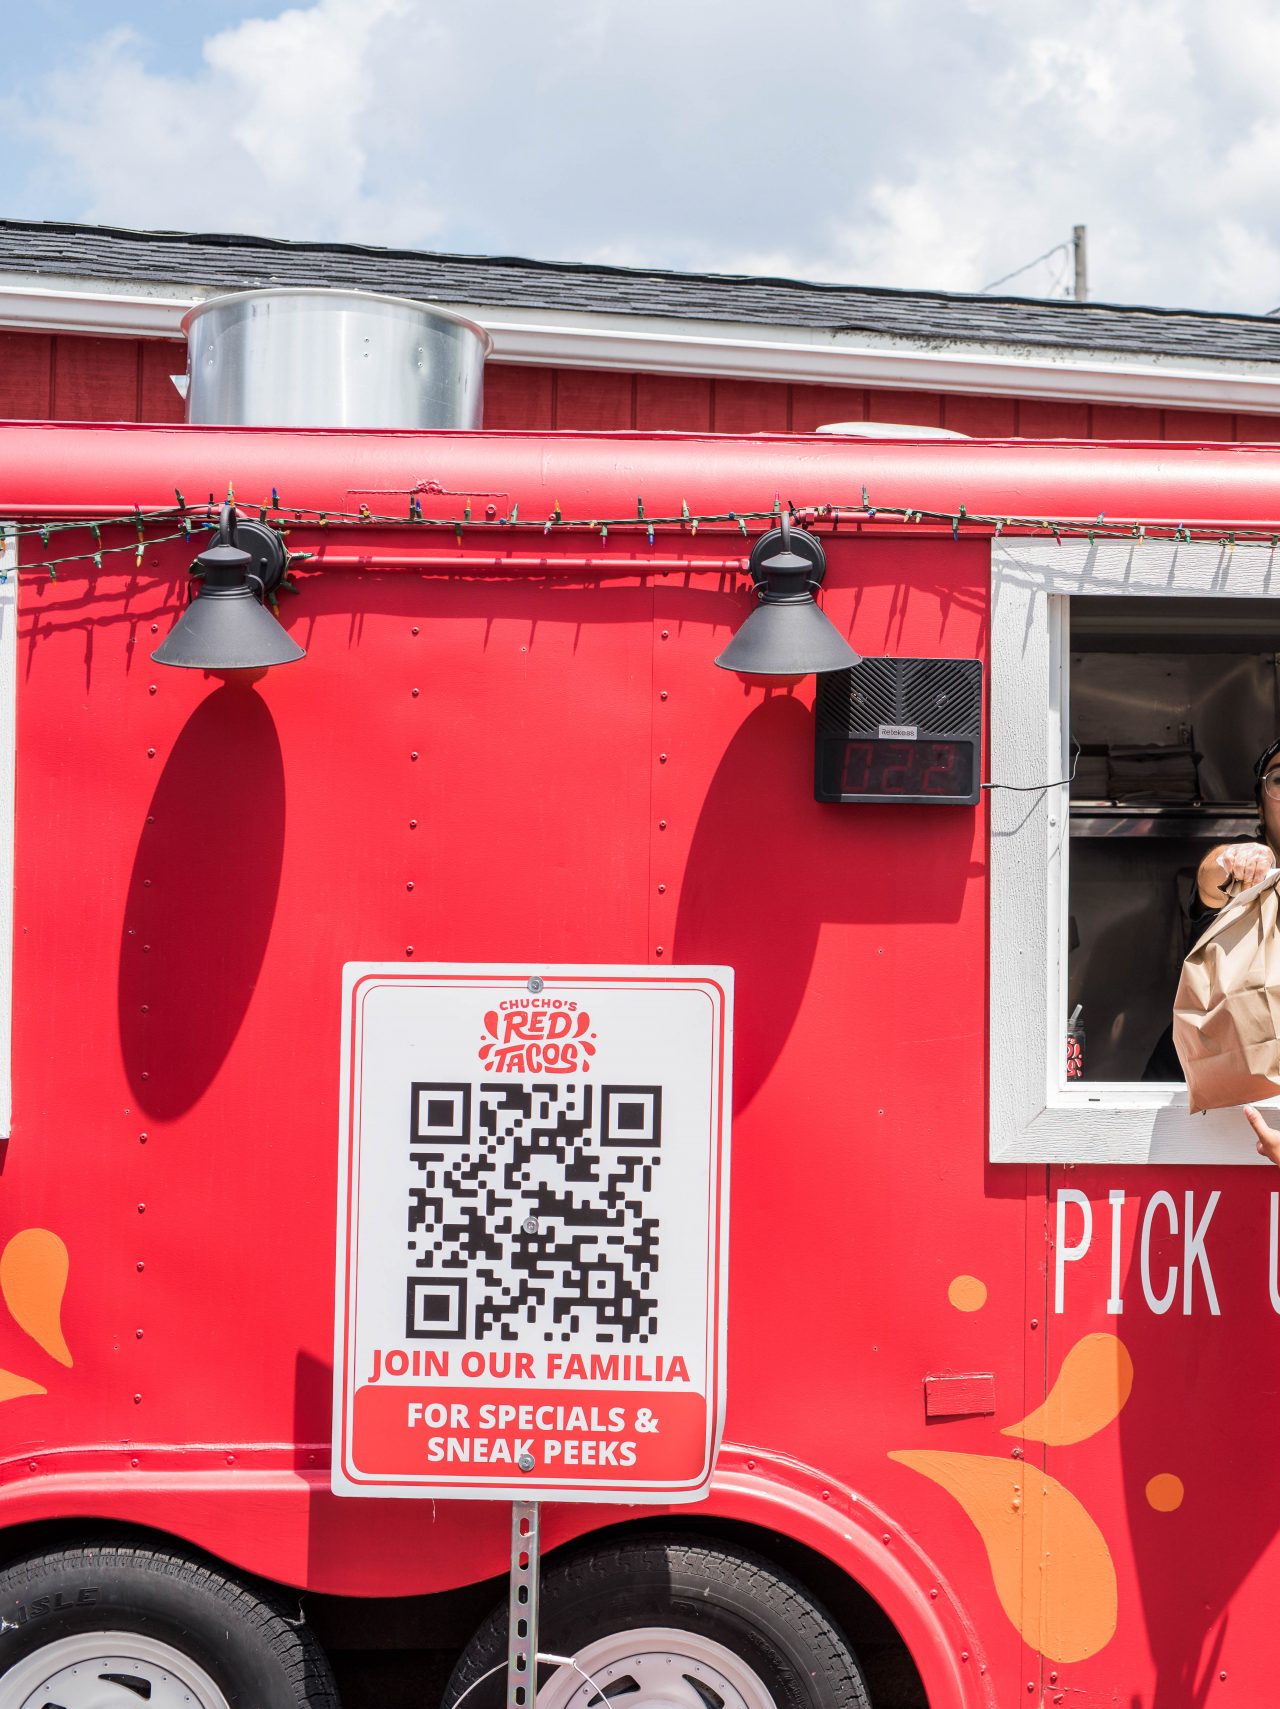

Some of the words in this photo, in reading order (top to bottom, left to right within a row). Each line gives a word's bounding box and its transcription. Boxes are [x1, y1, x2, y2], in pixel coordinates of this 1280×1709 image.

[499, 998, 577, 1011] CHUCHO'S
[503, 1010, 572, 1044] RED
[494, 1043, 578, 1074] TACOS
[1054, 1188, 1221, 1316] PICK
[368, 1350, 449, 1383] JOIN
[461, 1351, 536, 1379] OUR
[546, 1353, 691, 1382] FAMILIA
[407, 1402, 471, 1429] FOR
[479, 1404, 625, 1433] SPECIALS
[634, 1407, 660, 1433] &
[427, 1437, 535, 1464] SNEAK
[543, 1439, 638, 1466] PEEKS
